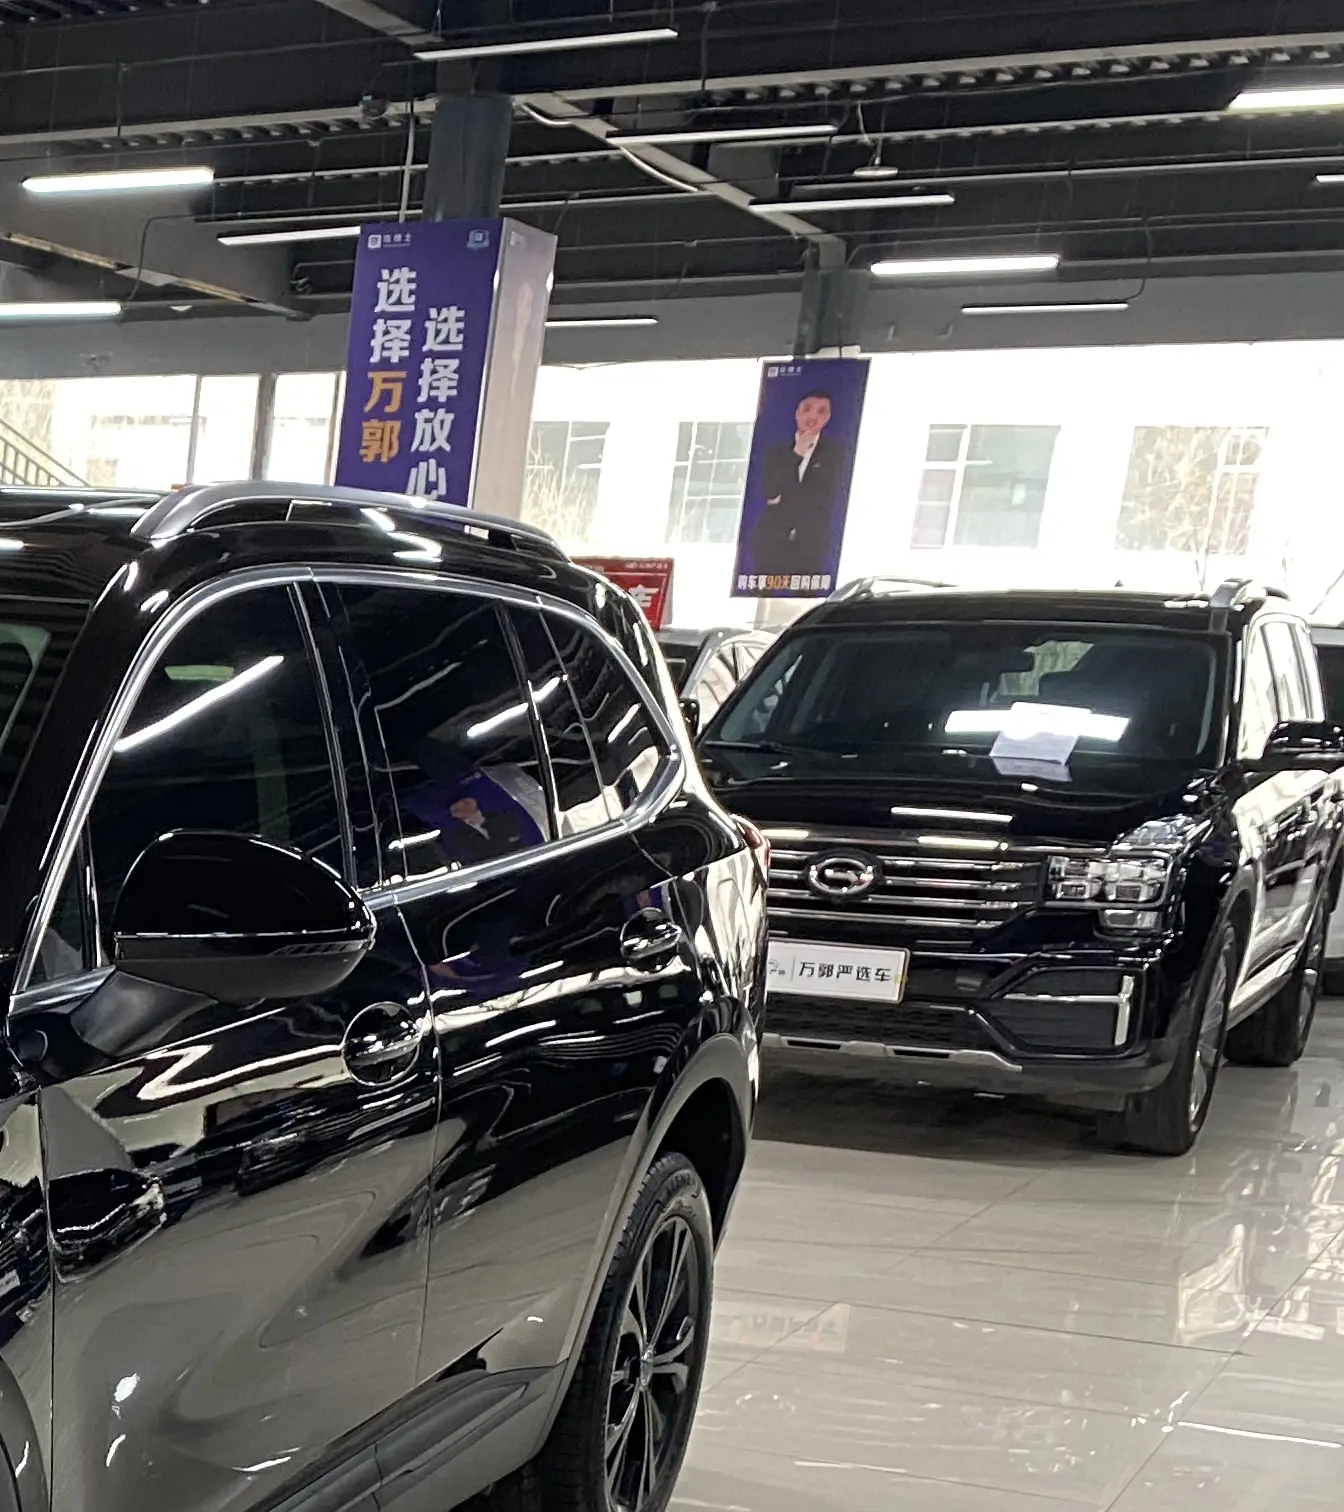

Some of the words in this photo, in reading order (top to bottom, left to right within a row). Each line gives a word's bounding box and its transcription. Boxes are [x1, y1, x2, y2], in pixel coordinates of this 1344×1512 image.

[359, 266, 417, 464] 选择万郭
[406, 305, 466, 501] 选择放心
[798, 960, 893, 983] 万郭严选车
